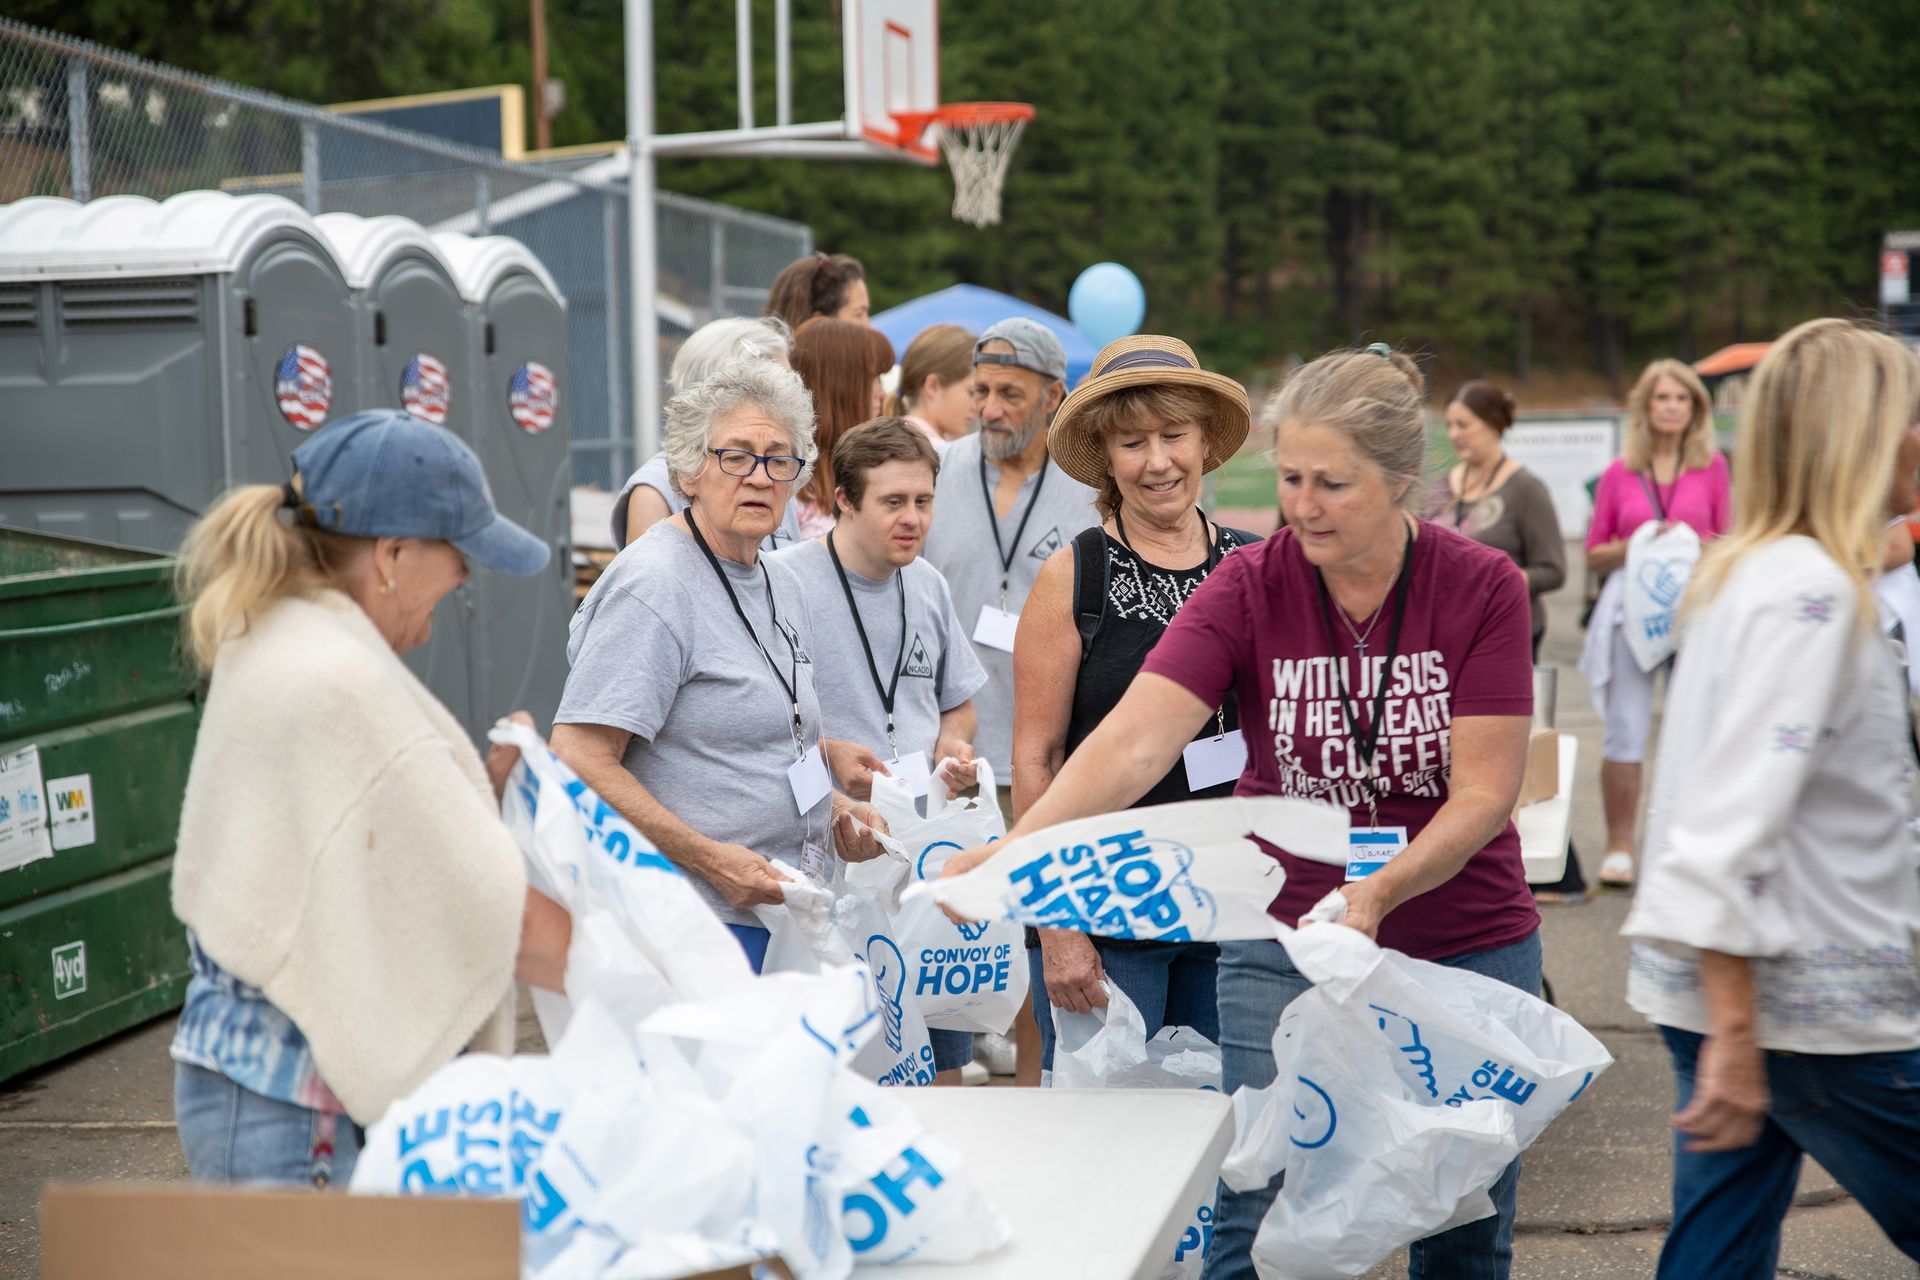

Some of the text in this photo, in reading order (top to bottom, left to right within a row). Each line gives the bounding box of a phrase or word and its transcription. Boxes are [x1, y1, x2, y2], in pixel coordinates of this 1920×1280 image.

[1272, 650, 1449, 700] WITH JESUS
[1269, 698, 1297, 735] IN
[56, 788, 85, 811] WM
[55, 948, 84, 990] 4yd
[920, 944, 1010, 964] CONVOY OF
[916, 961, 1010, 996] HOPE
[1472, 1059, 1500, 1088] OF
